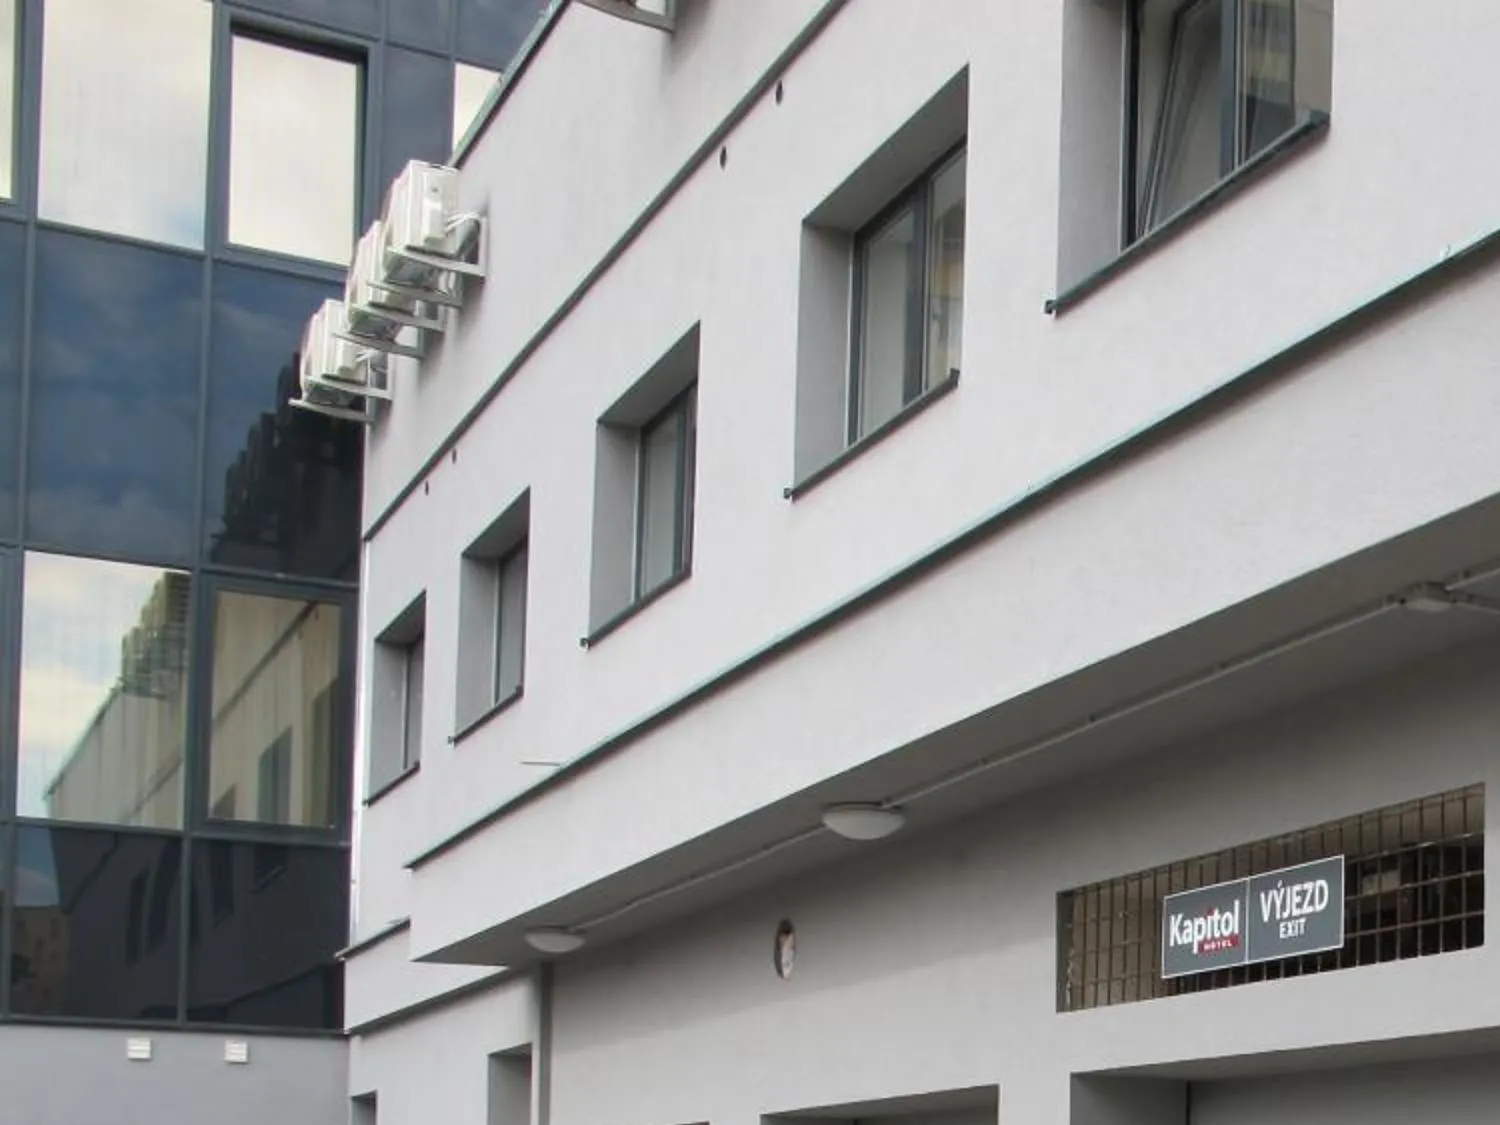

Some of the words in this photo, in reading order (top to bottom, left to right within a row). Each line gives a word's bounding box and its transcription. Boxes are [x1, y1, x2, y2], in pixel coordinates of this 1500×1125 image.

[1259, 879, 1329, 923] VÝJEZD
[1169, 900, 1240, 954] Kapitol
[1279, 917, 1307, 939] EXIT
[1203, 940, 1233, 951] HOTEL
